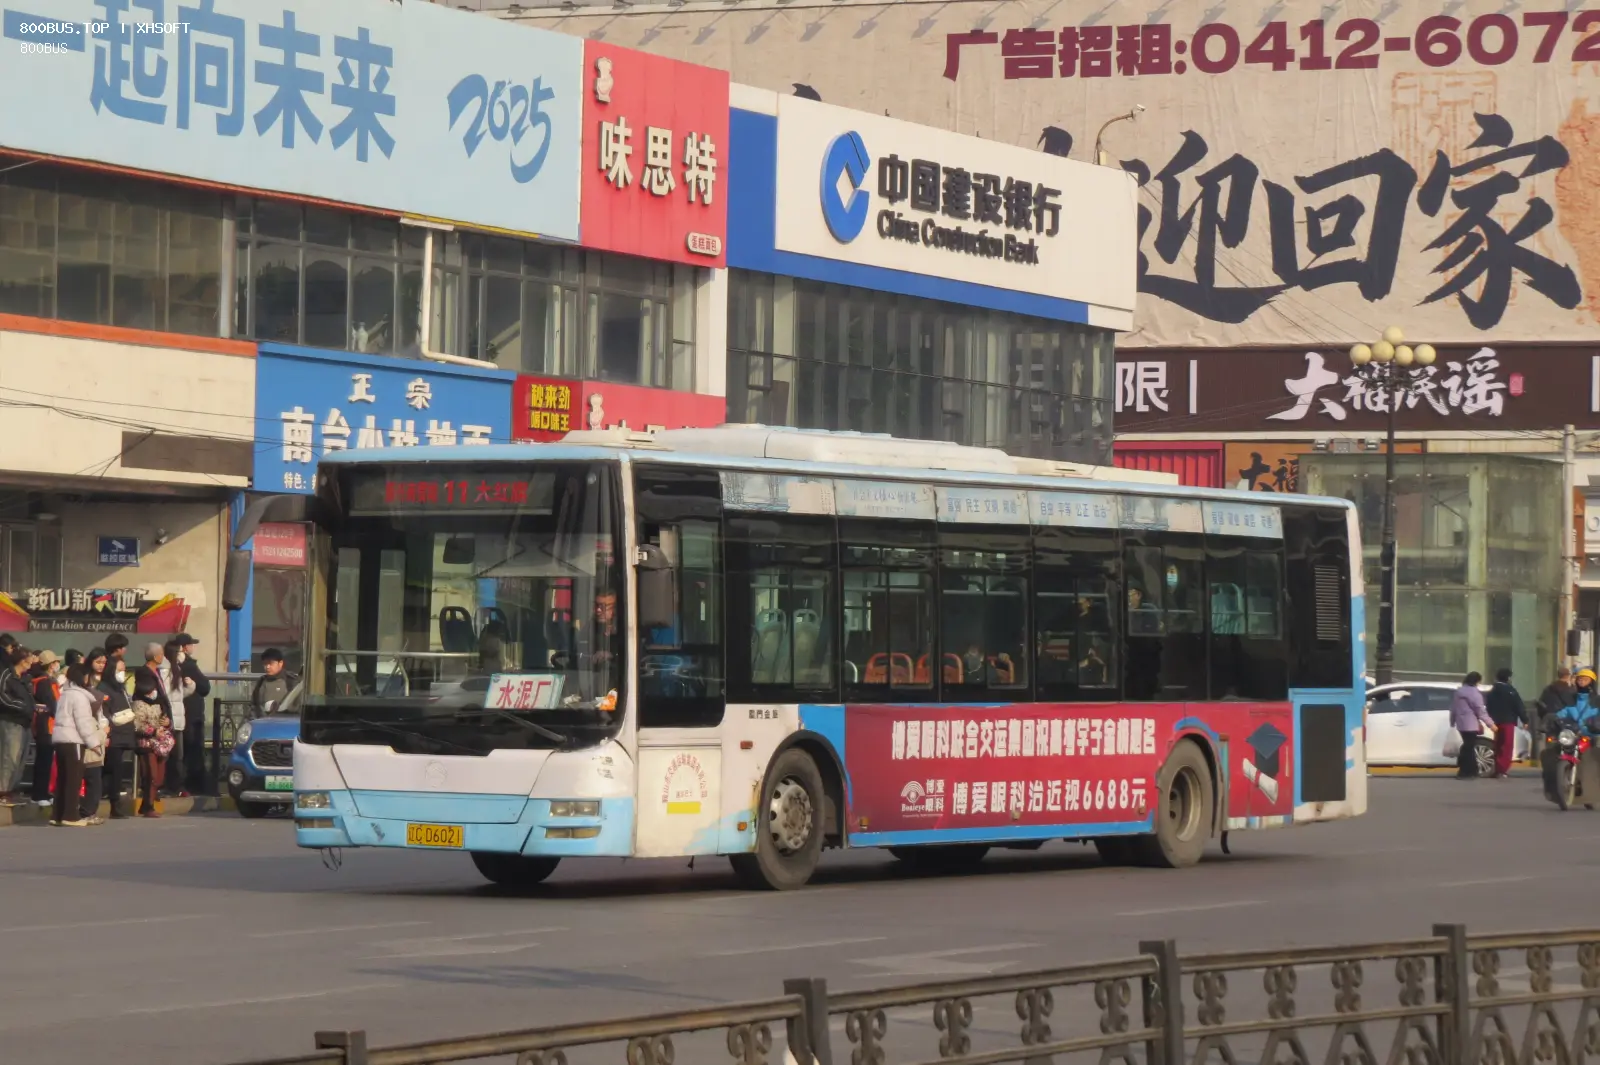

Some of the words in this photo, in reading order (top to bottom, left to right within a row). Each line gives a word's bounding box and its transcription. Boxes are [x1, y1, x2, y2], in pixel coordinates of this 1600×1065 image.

[3, 0, 396, 163] 一起向未来
[599, 116, 718, 205] 味思特
[877, 154, 1062, 237] 中国建设银行
[1038, 112, 1582, 330] 迎回家
[877, 209, 920, 245] China
[921, 218, 1004, 260] Construction
[1004, 234, 1040, 266] Bank
[348, 373, 433, 410] 正宗
[1115, 361, 1169, 413] 限
[444, 480, 469, 505] 11
[496, 680, 551, 709] 水泥厂
[952, 778, 1146, 815] 博爱眼科治近视6688元
